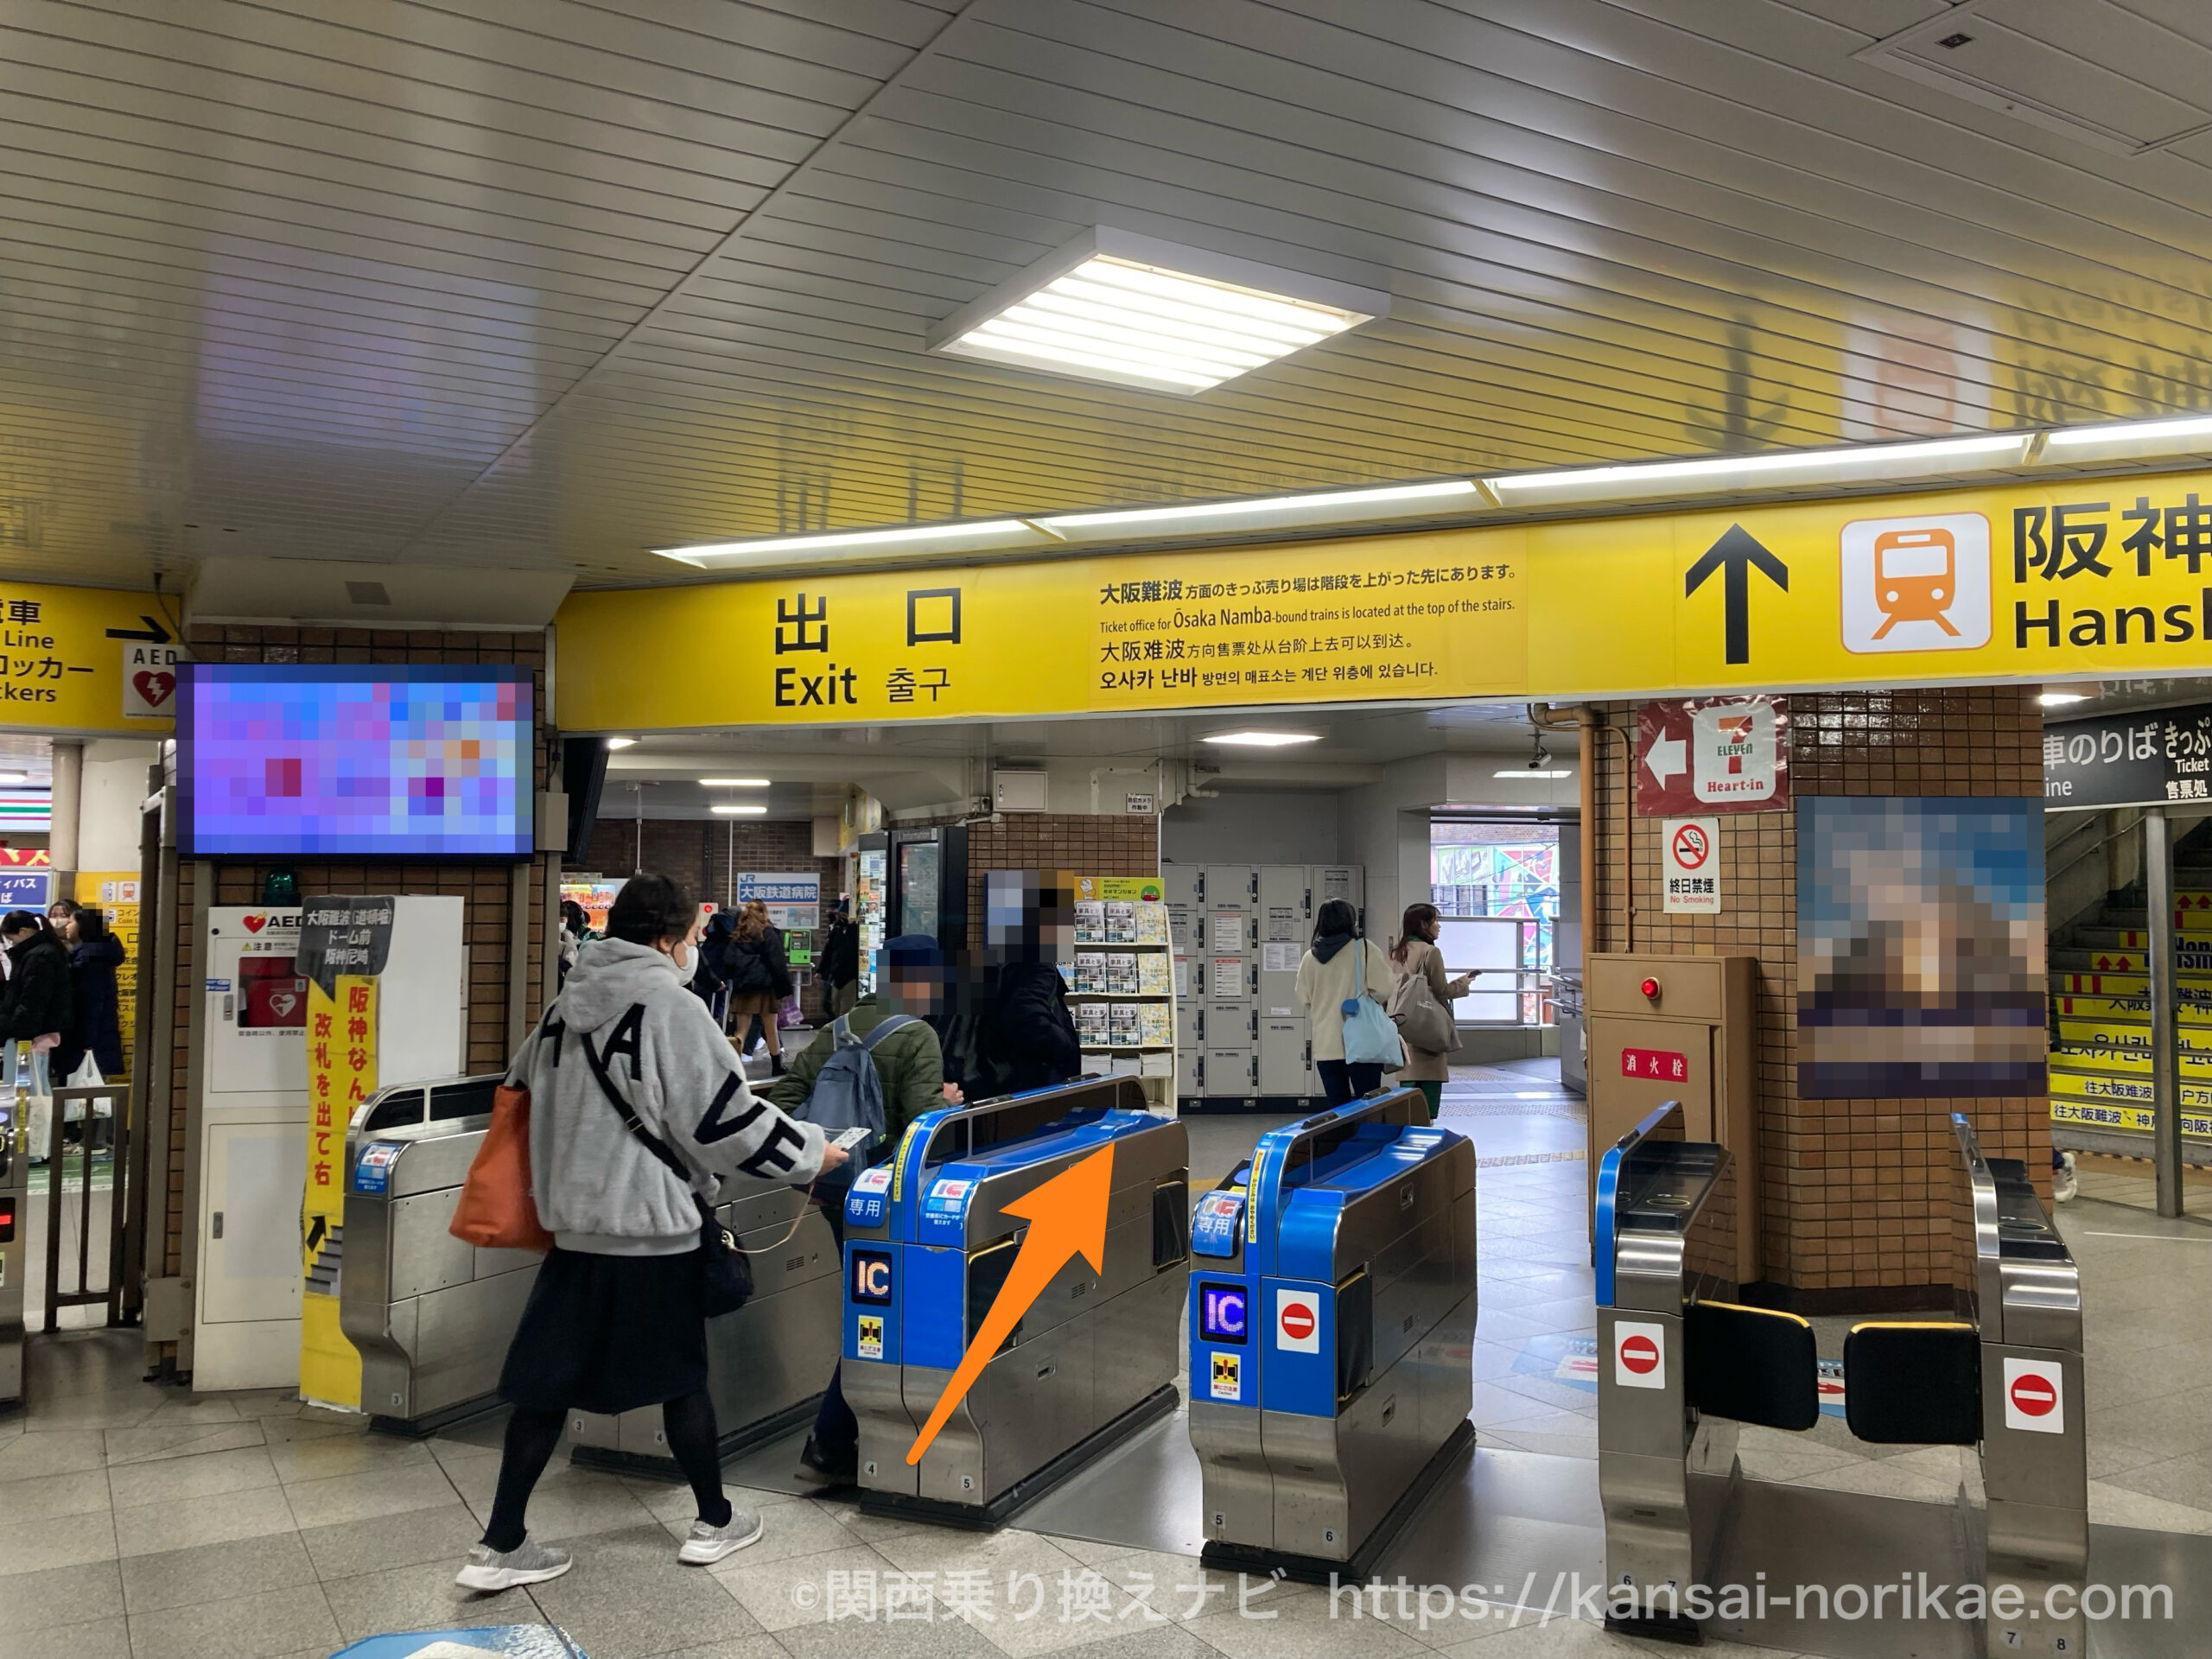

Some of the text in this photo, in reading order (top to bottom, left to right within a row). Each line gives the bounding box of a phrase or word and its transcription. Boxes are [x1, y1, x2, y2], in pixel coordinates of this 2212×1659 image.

[0, 599, 41, 626] 車
[775, 588, 961, 655] 出口
[1100, 620, 1128, 633] Ticket
[1129, 619, 1155, 632] office
[1158, 618, 1172, 630] for
[1310, 606, 1339, 621] trains
[1342, 607, 1351, 620] is
[1352, 604, 1390, 618] located
[1393, 605, 1404, 616] at
[1407, 602, 1425, 615] the
[1427, 602, 1445, 616] top
[1447, 600, 1459, 613] of
[1461, 599, 1479, 613] the
[1482, 598, 1516, 611] stairs.
[2015, 587, 2212, 648] Hans
[5, 630, 54, 649] Line
[886, 667, 950, 702] 출구
[1100, 661, 1438, 690] 오사카 난바 방면의 매표소는 계단 위층에 있습니다.
[775, 664, 857, 707] Exit
[2175, 758, 2209, 773] Ticket
[1707, 779, 1764, 792] Heart-in
[2045, 778, 2072, 797] ine
[741, 886, 817, 899] 大阪鉄道病院
[1669, 878, 1714, 893] 終日禁煙
[1683, 896, 1714, 906] Smoking
[328, 930, 372, 944] ドーム前
[1626, 1054, 1683, 1077] 消火栓
[315, 1013, 332, 1186] 改札を出て右
[849, 1198, 880, 1217] 専用
[858, 1260, 888, 1295] IC
[1208, 1294, 1243, 1332] IC
[868, 1464, 874, 1474] 4
[963, 1478, 969, 1489] 5
[1216, 1515, 1223, 1525] 5
[1325, 1531, 1333, 1541] 6
[2006, 1631, 2016, 1643] 7
[2056, 1638, 2066, 1650] 8
